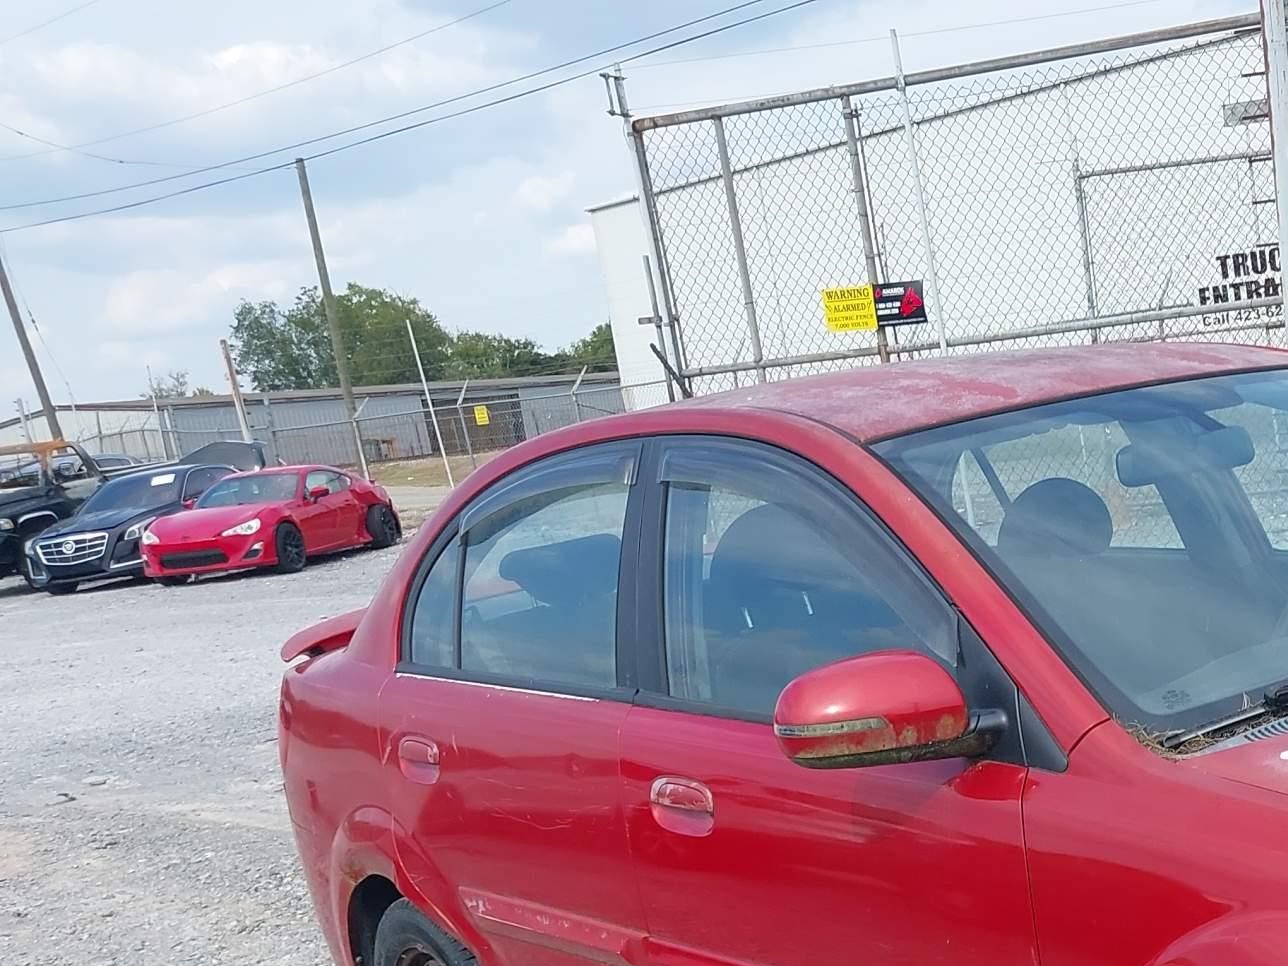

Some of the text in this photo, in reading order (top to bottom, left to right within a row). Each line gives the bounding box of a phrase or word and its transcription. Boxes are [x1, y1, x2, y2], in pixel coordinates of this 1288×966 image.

[1215, 247, 1282, 279] TRUC
[825, 288, 869, 300] WARNING
[833, 303, 867, 313] ALARMED
[828, 313, 873, 323] ELECTRIC FENCE
[1202, 314, 1230, 327] Call
